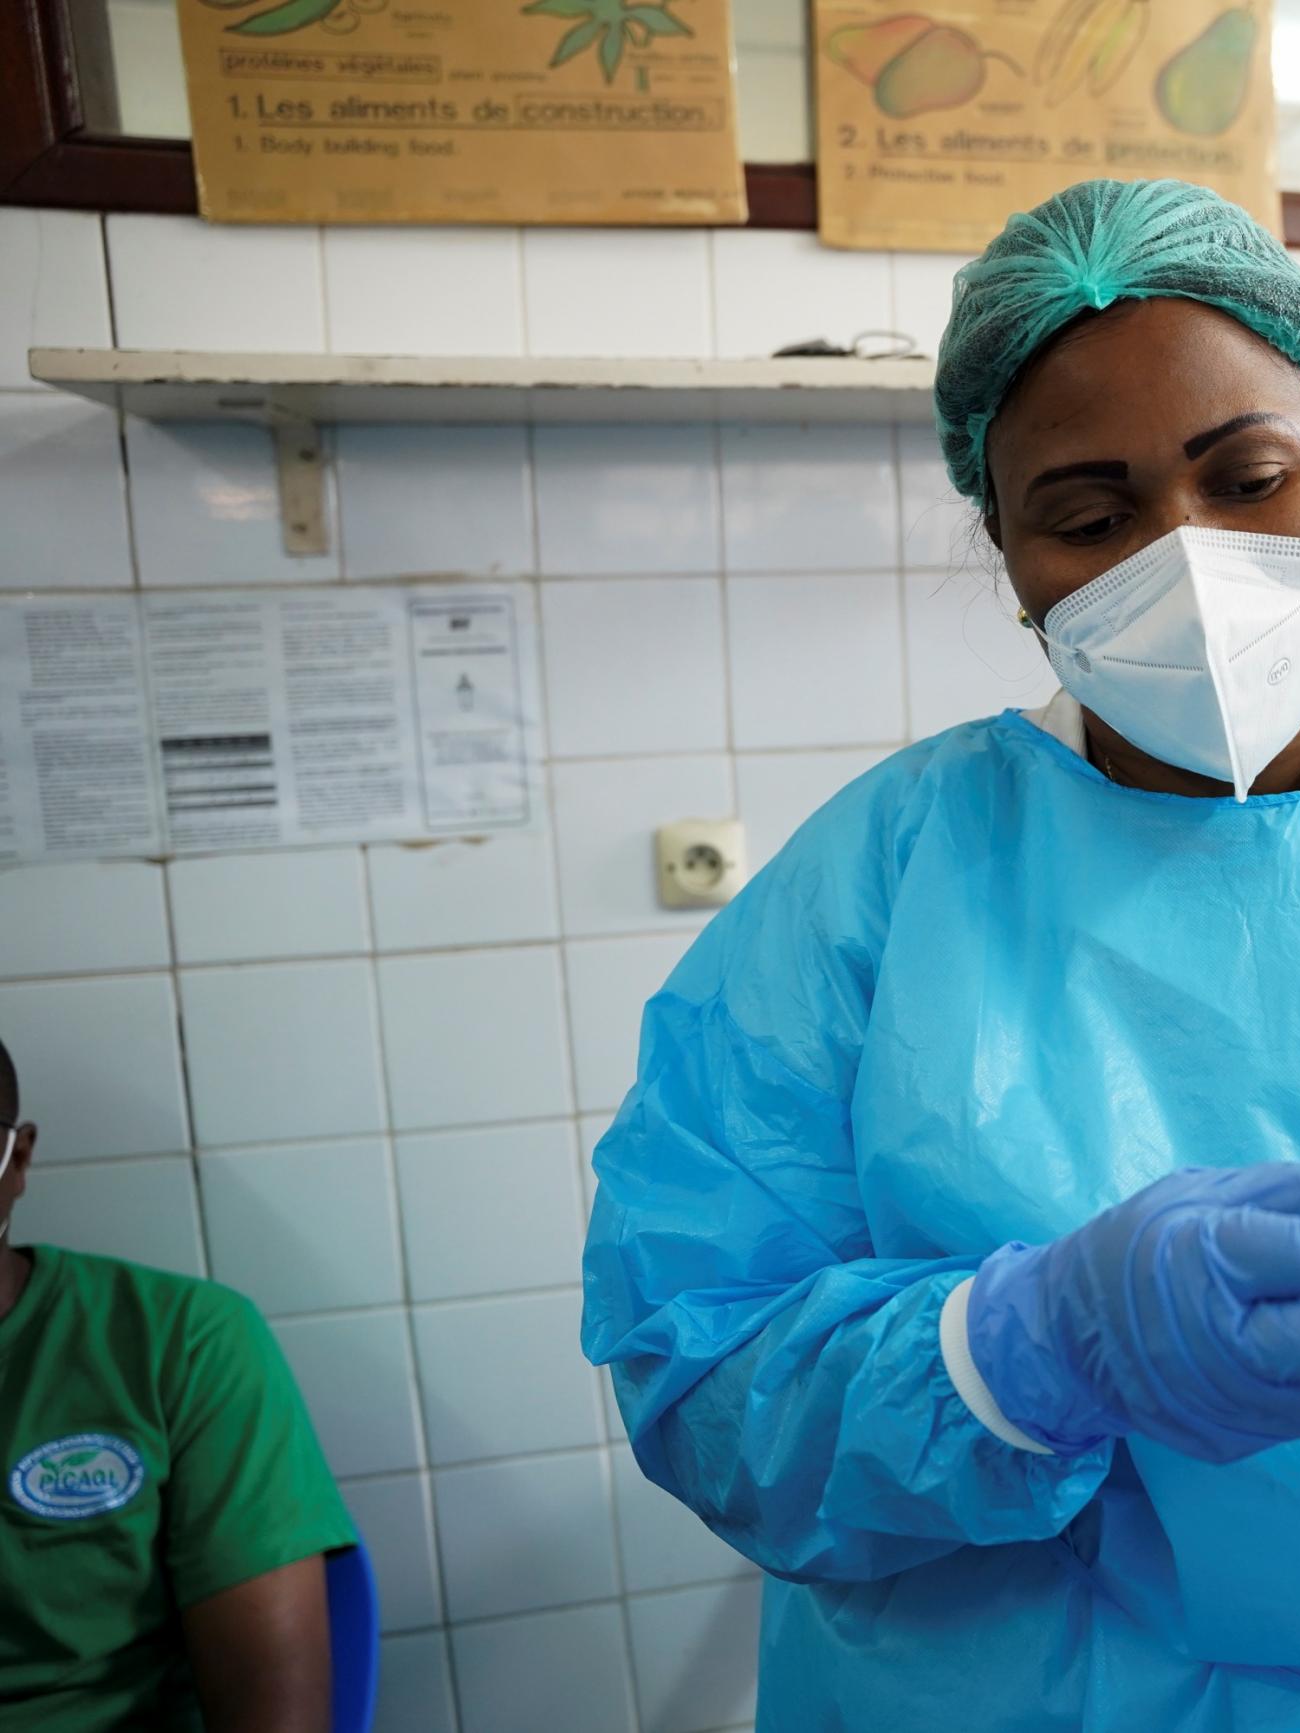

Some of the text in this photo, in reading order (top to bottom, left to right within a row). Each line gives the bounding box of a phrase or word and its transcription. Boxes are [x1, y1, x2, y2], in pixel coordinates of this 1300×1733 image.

[257, 94, 313, 120] Les
[330, 96, 457, 120] aliments
[473, 98, 508, 122] de
[260, 136, 312, 155] Body
[324, 138, 400, 158] building
[876, 127, 928, 151] Les
[941, 130, 1050, 156] aliments
